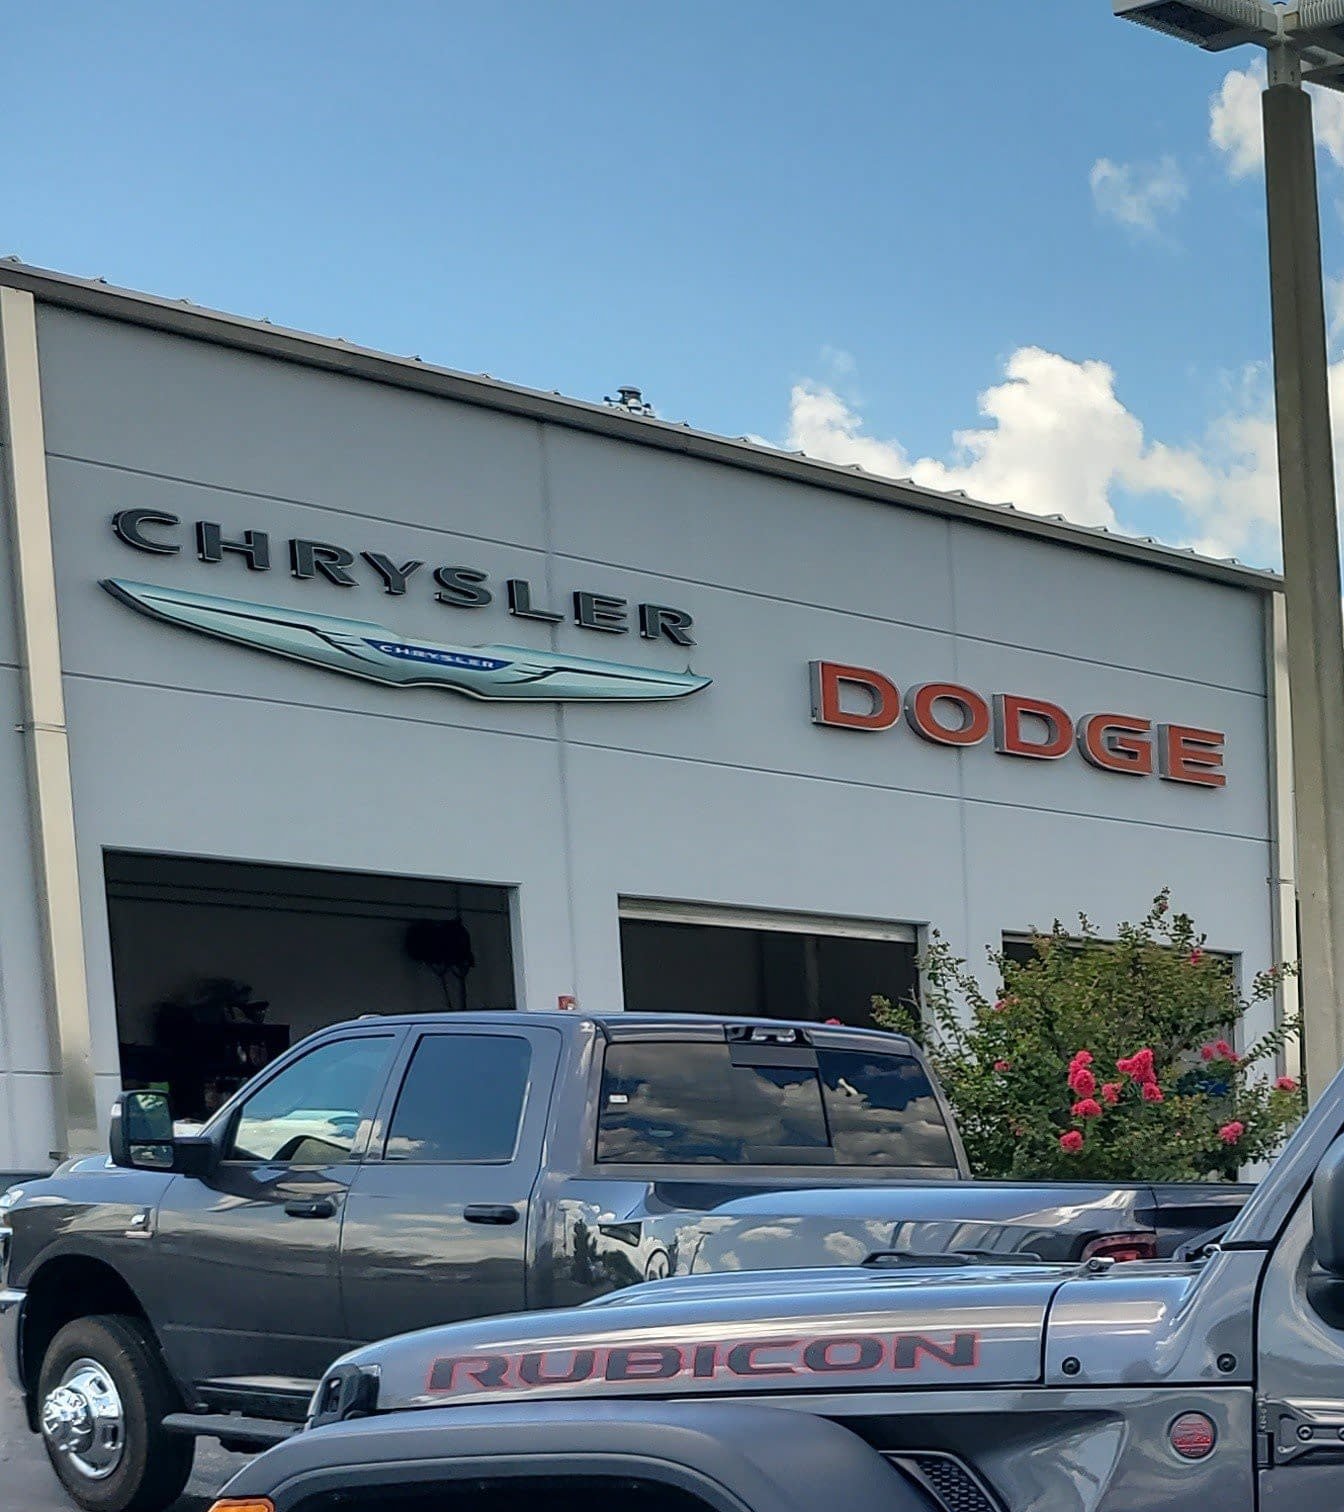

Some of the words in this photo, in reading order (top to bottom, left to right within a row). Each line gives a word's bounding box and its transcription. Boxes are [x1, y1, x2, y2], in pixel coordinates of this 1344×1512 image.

[112, 508, 698, 646] CHRYSLER
[380, 644, 495, 668] CHRYSLER
[809, 659, 1227, 788] DODGE
[426, 1332, 980, 1393] RUBICON
